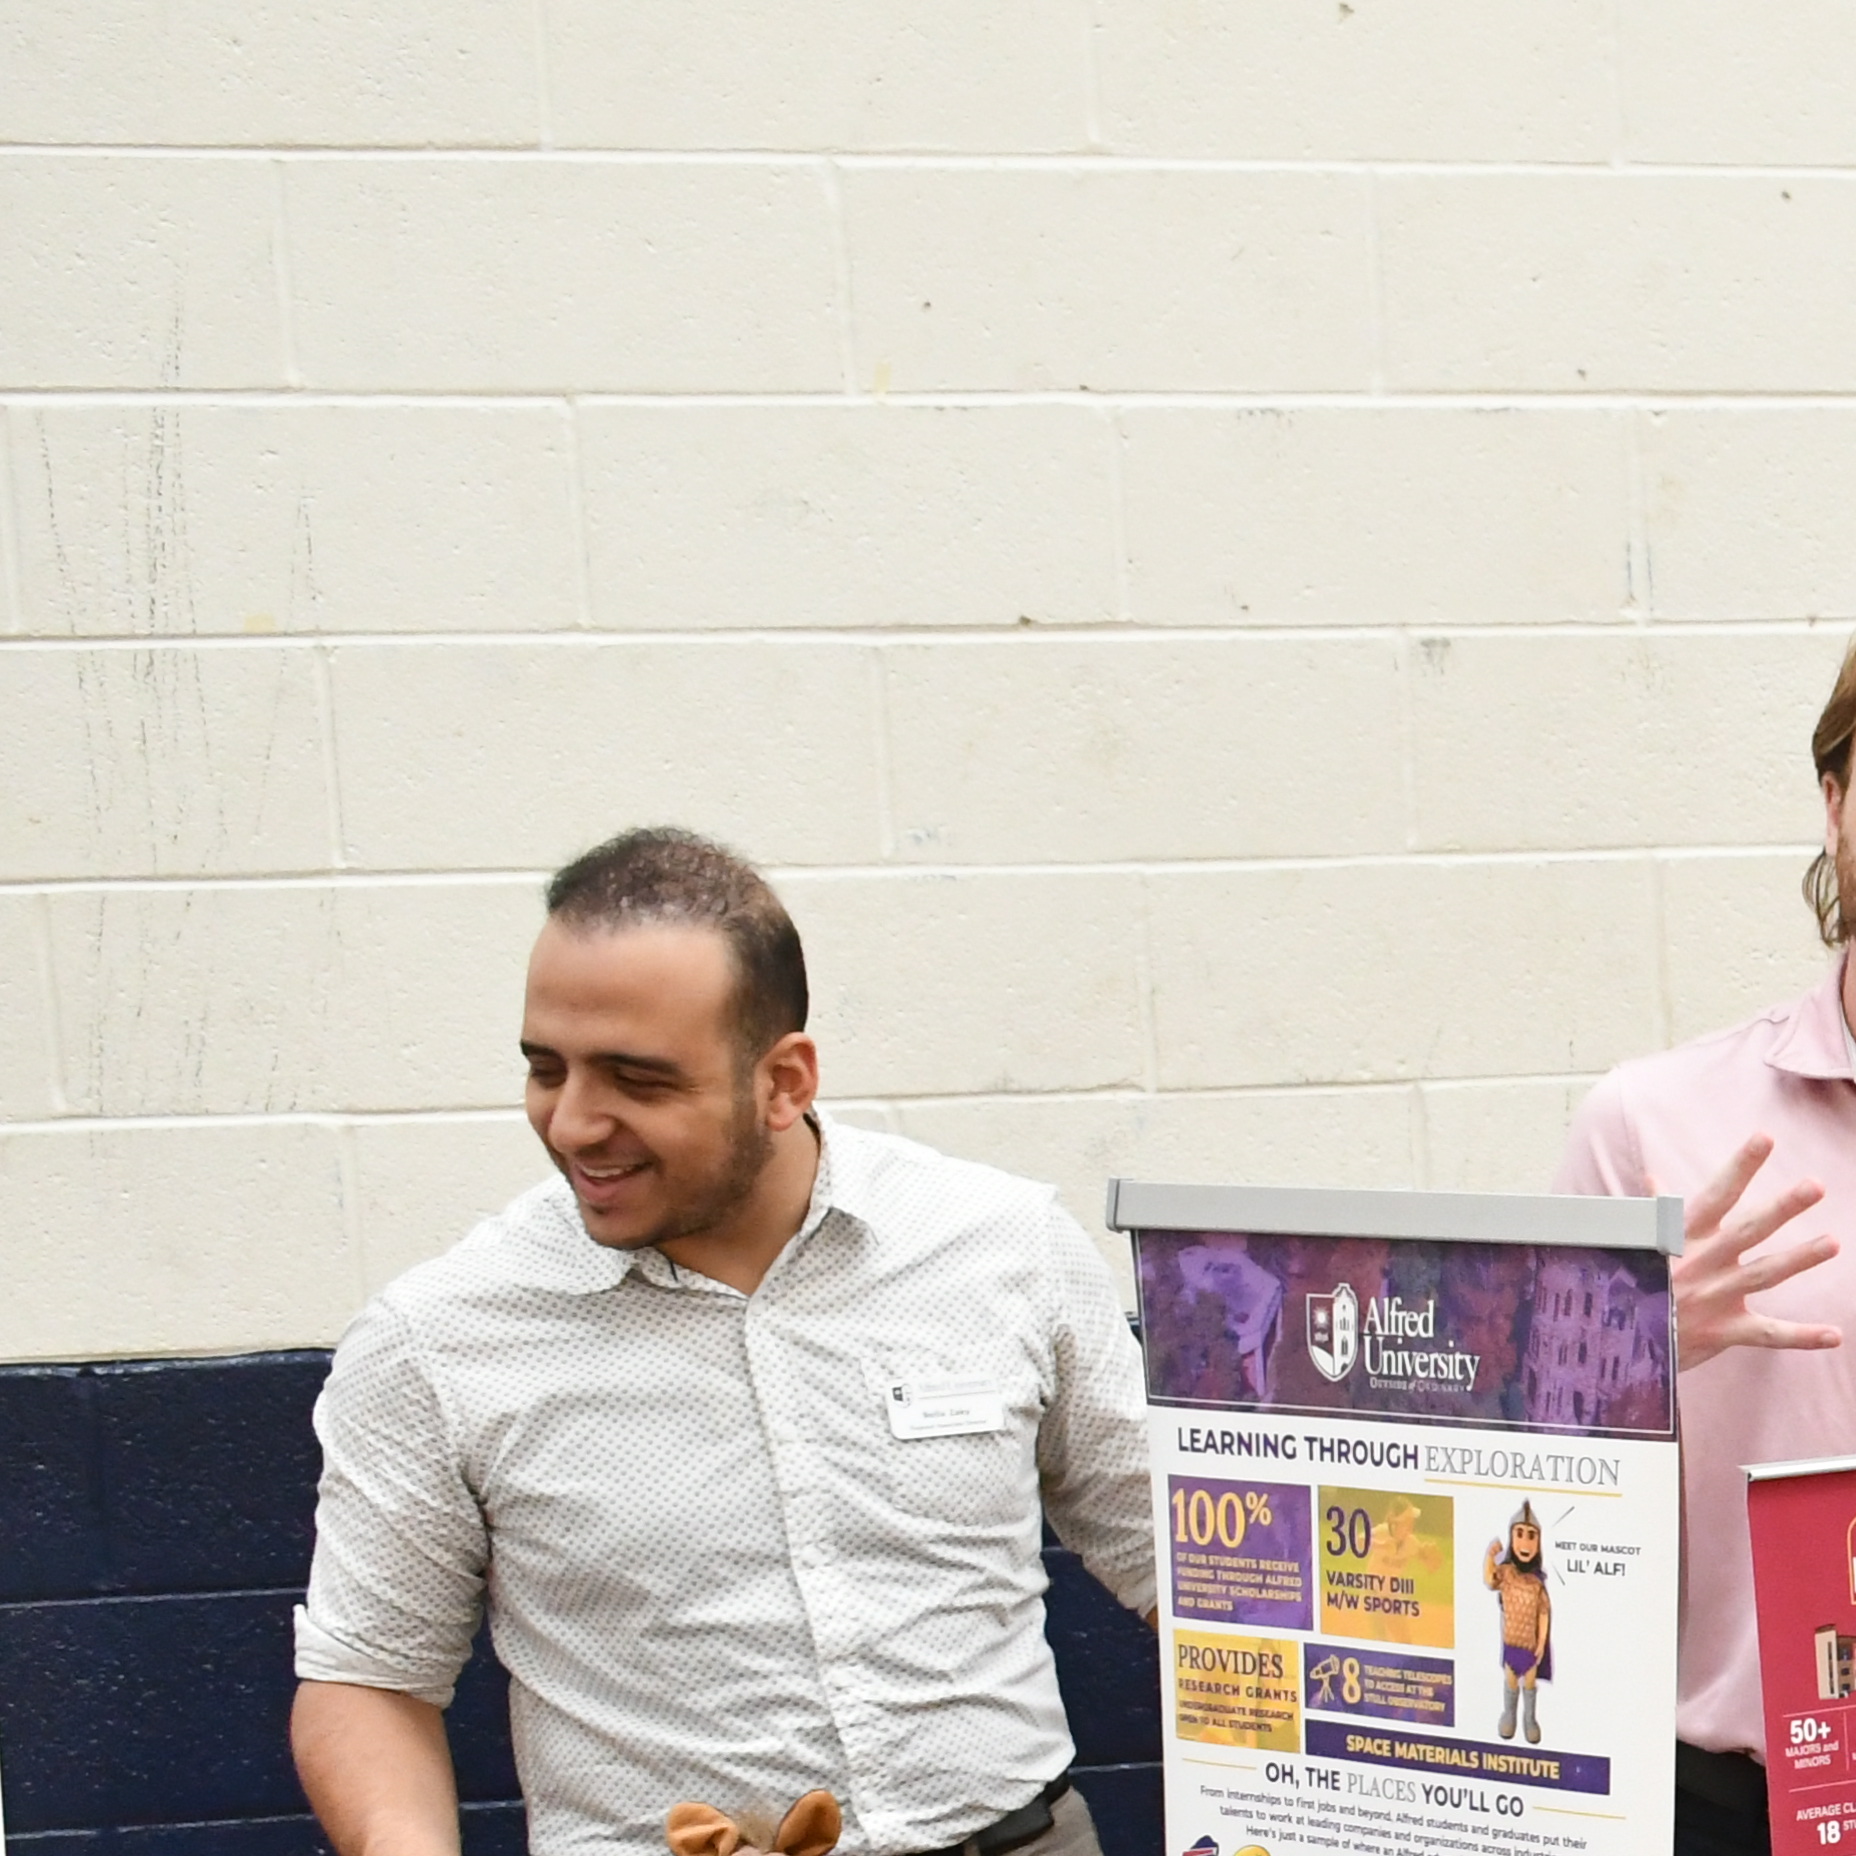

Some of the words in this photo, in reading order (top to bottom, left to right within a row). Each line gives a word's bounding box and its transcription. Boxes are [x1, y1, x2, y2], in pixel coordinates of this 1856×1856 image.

[1364, 1297, 1434, 1338] Alfred
[1364, 1336, 1480, 1392] University
[1178, 1427, 1297, 1460] LEARNING
[1305, 1436, 1419, 1470] THROUGH
[1425, 1444, 1622, 1486] EXPLORATION
[1172, 1488, 1272, 1548] 100%
[1326, 1505, 1371, 1559] 30
[1326, 1570, 1385, 1592] VARSITY
[1594, 1562, 1626, 1576] ALF!
[1327, 1592, 1359, 1611] M/W
[1364, 1596, 1420, 1618] SPORTS
[1178, 1644, 1283, 1679] PROVIDES
[1342, 1656, 1361, 1704] 8
[1178, 1678, 1240, 1696] RESEARCH
[1246, 1686, 1297, 1702] GRANTS
[1790, 1718, 1831, 1744] 50+
[1346, 1735, 1391, 1758] SPACE
[1395, 1741, 1479, 1769] MATERIALS
[1483, 1753, 1560, 1780] INSTITUTE
[1265, 1761, 1300, 1788] OH,
[1305, 1766, 1341, 1791] THE
[1347, 1772, 1416, 1803] PLACES
[1421, 1783, 1490, 1814] YOU'LL
[1495, 1794, 1524, 1817] GO
[1797, 1804, 1841, 1821] AVERAGE
[1817, 1820, 1841, 1845] 18
